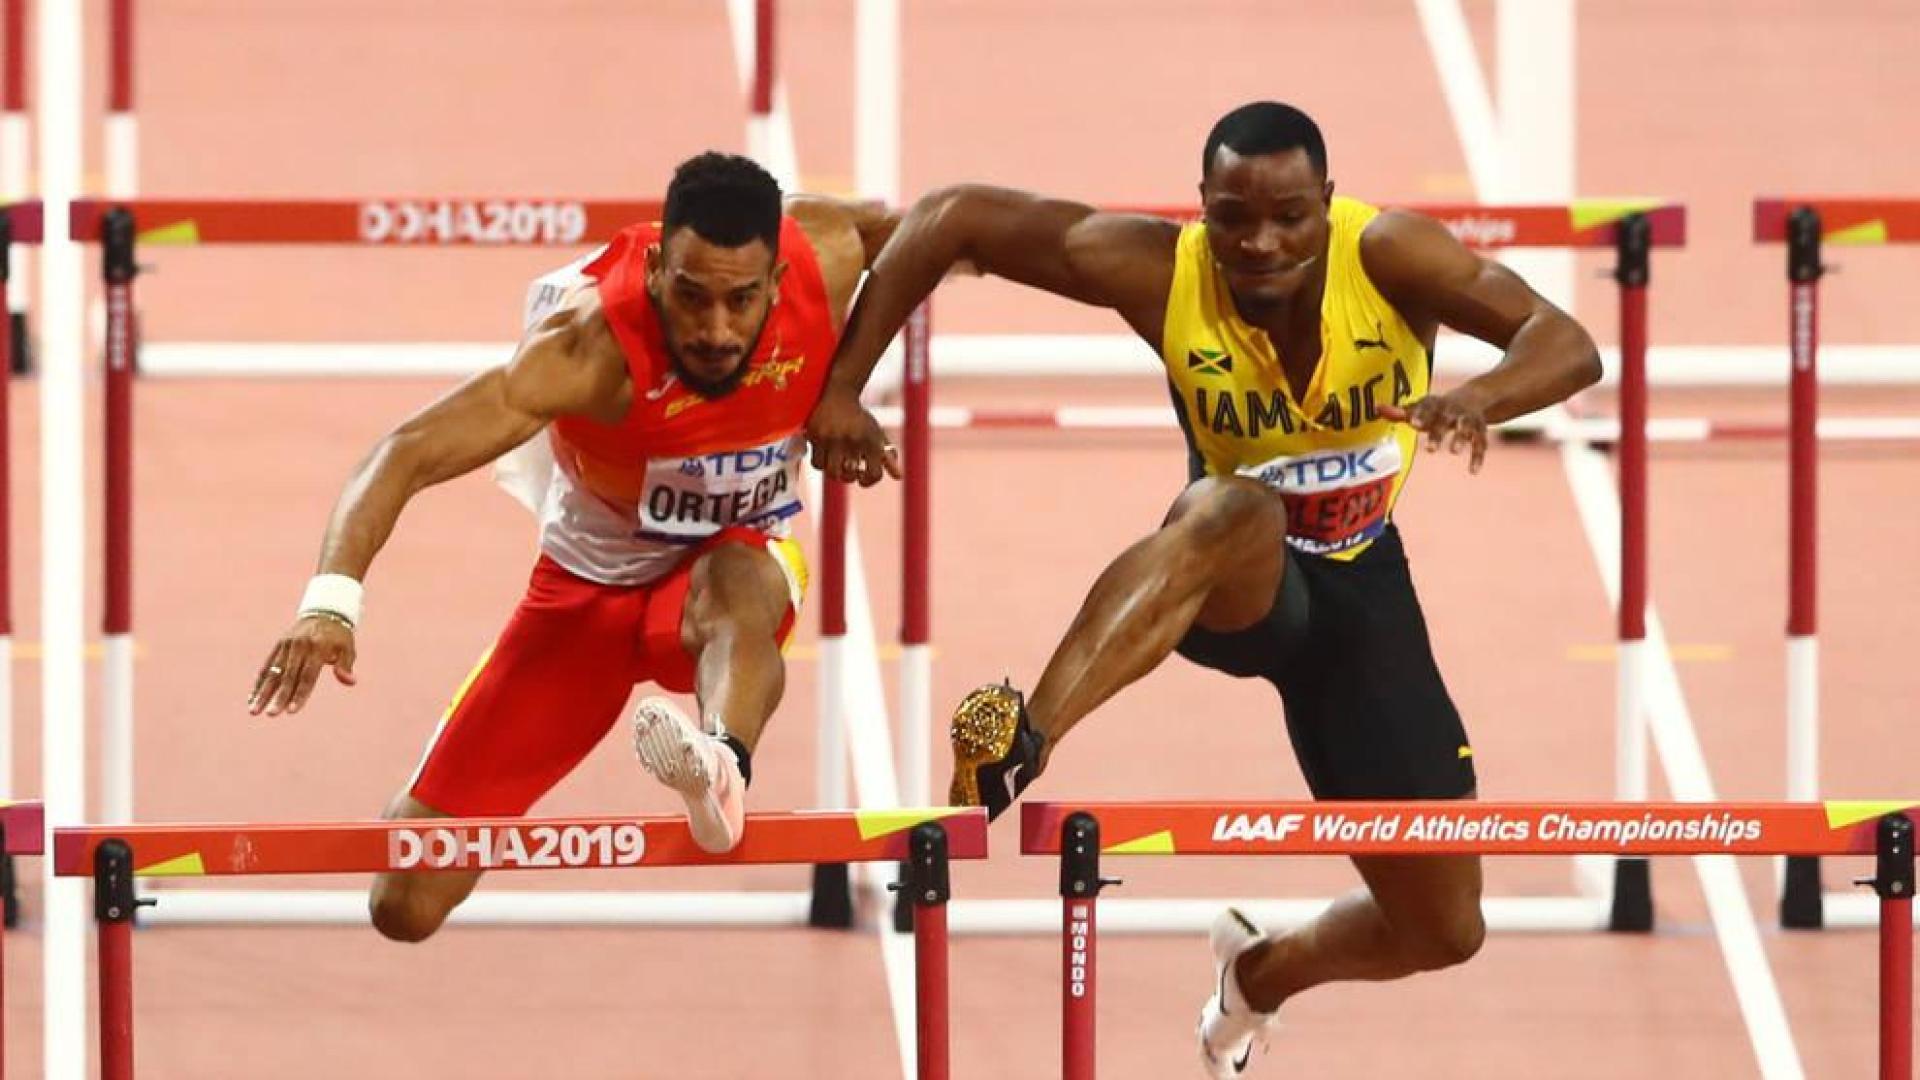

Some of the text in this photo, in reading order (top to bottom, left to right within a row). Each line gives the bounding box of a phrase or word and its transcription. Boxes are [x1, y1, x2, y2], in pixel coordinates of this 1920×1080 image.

[705, 446, 789, 476] TDK
[1285, 447, 1377, 486] TDK
[649, 468, 788, 523] ORTEGA
[388, 824, 645, 869] DOHA2019
[1211, 813, 1762, 846] IAAF World Athletics Championships
[1070, 921, 1089, 998] MONDO
